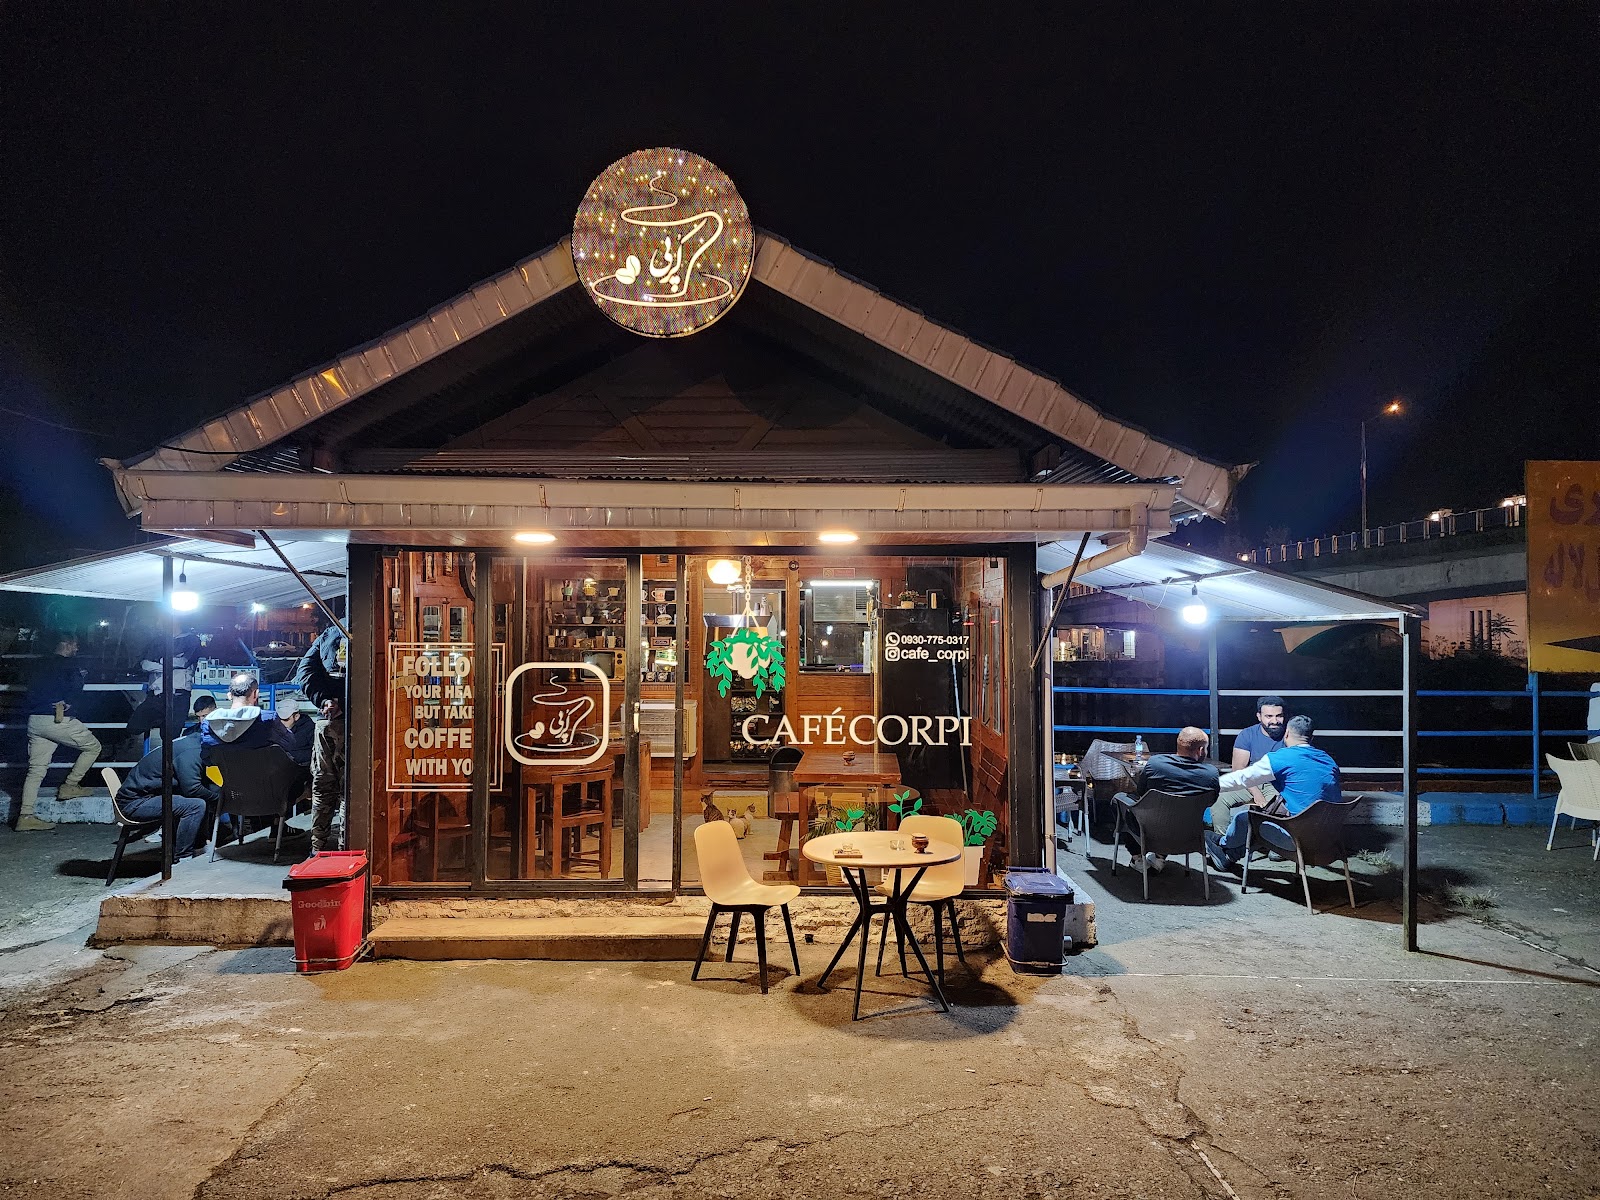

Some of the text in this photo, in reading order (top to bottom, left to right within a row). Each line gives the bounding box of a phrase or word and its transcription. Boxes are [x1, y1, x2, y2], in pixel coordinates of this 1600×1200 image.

[901, 635, 969, 645] 0930-775-0317
[901, 647, 969, 663] cafe_corpi
[403, 656, 475, 677] FOLLO
[405, 685, 475, 698] YOUR HEA
[415, 706, 439, 719] BUT
[404, 728, 472, 749] COFFE
[406, 759, 473, 776] WITH YO
